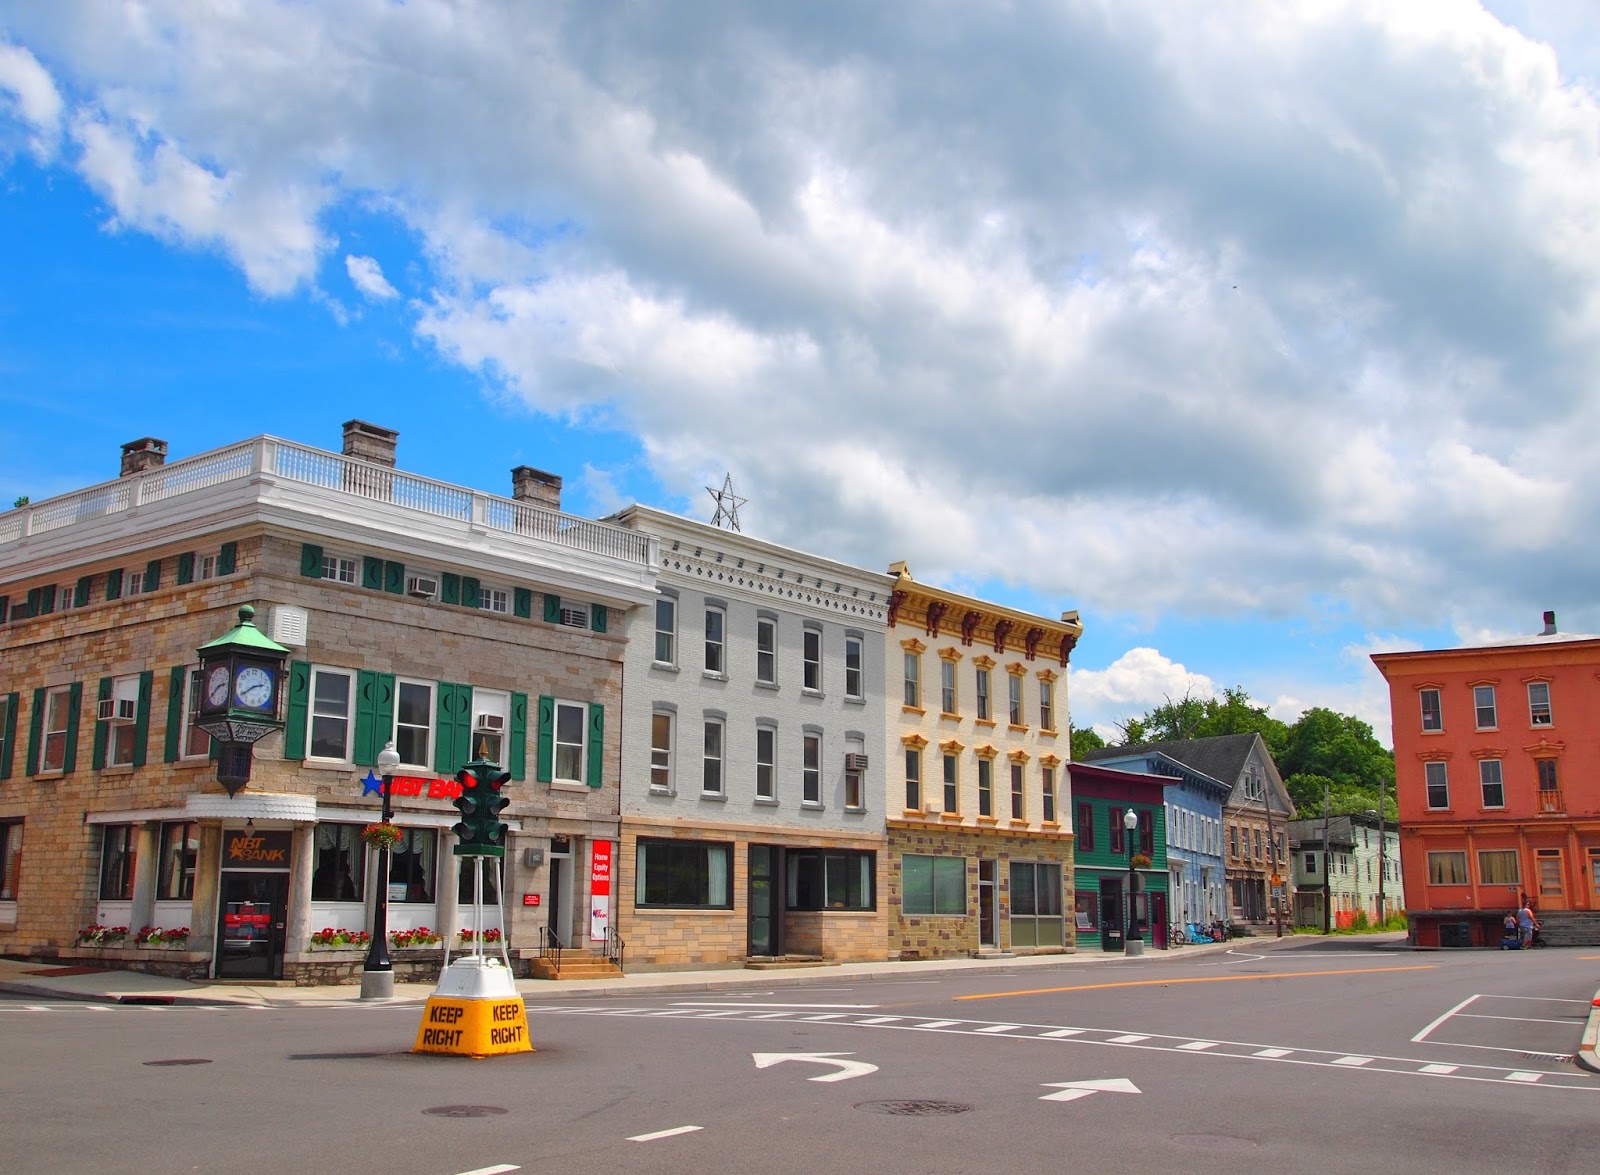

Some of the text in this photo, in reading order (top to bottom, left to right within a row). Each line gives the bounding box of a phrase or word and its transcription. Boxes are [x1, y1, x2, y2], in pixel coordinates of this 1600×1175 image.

[231, 837, 265, 849] NBT
[594, 853, 608, 861] Home
[593, 863, 608, 872] Equity
[592, 873, 609, 882] Options
[430, 1005, 463, 1024] KEEP
[493, 1004, 519, 1022] KEEP
[423, 1028, 463, 1047] RIGHT
[491, 1026, 522, 1045] RIGHT
